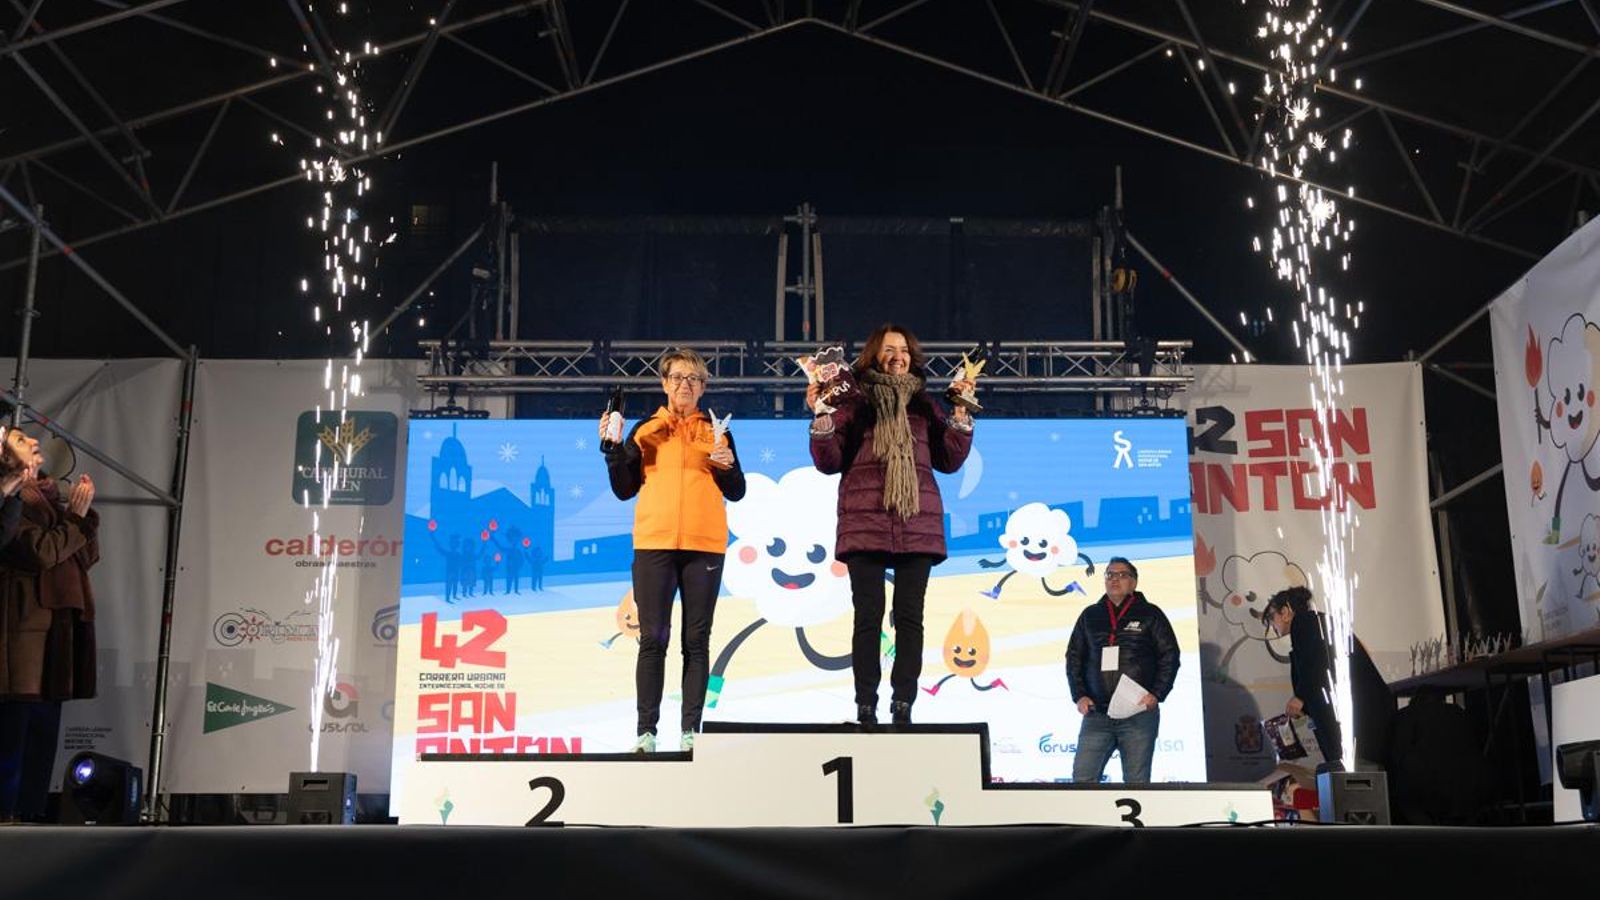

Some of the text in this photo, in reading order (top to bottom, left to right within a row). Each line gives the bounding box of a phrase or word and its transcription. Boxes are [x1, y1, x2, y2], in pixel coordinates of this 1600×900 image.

[1187, 406, 1370, 457] 2 SAN
[339, 467, 388, 479] RURAL
[420, 609, 508, 669] 42
[419, 672, 506, 682] CARRERA URBANA
[416, 691, 516, 734] SAN
[524, 776, 566, 828] 2
[821, 756, 854, 824] 1
[1115, 798, 1145, 828] 3
